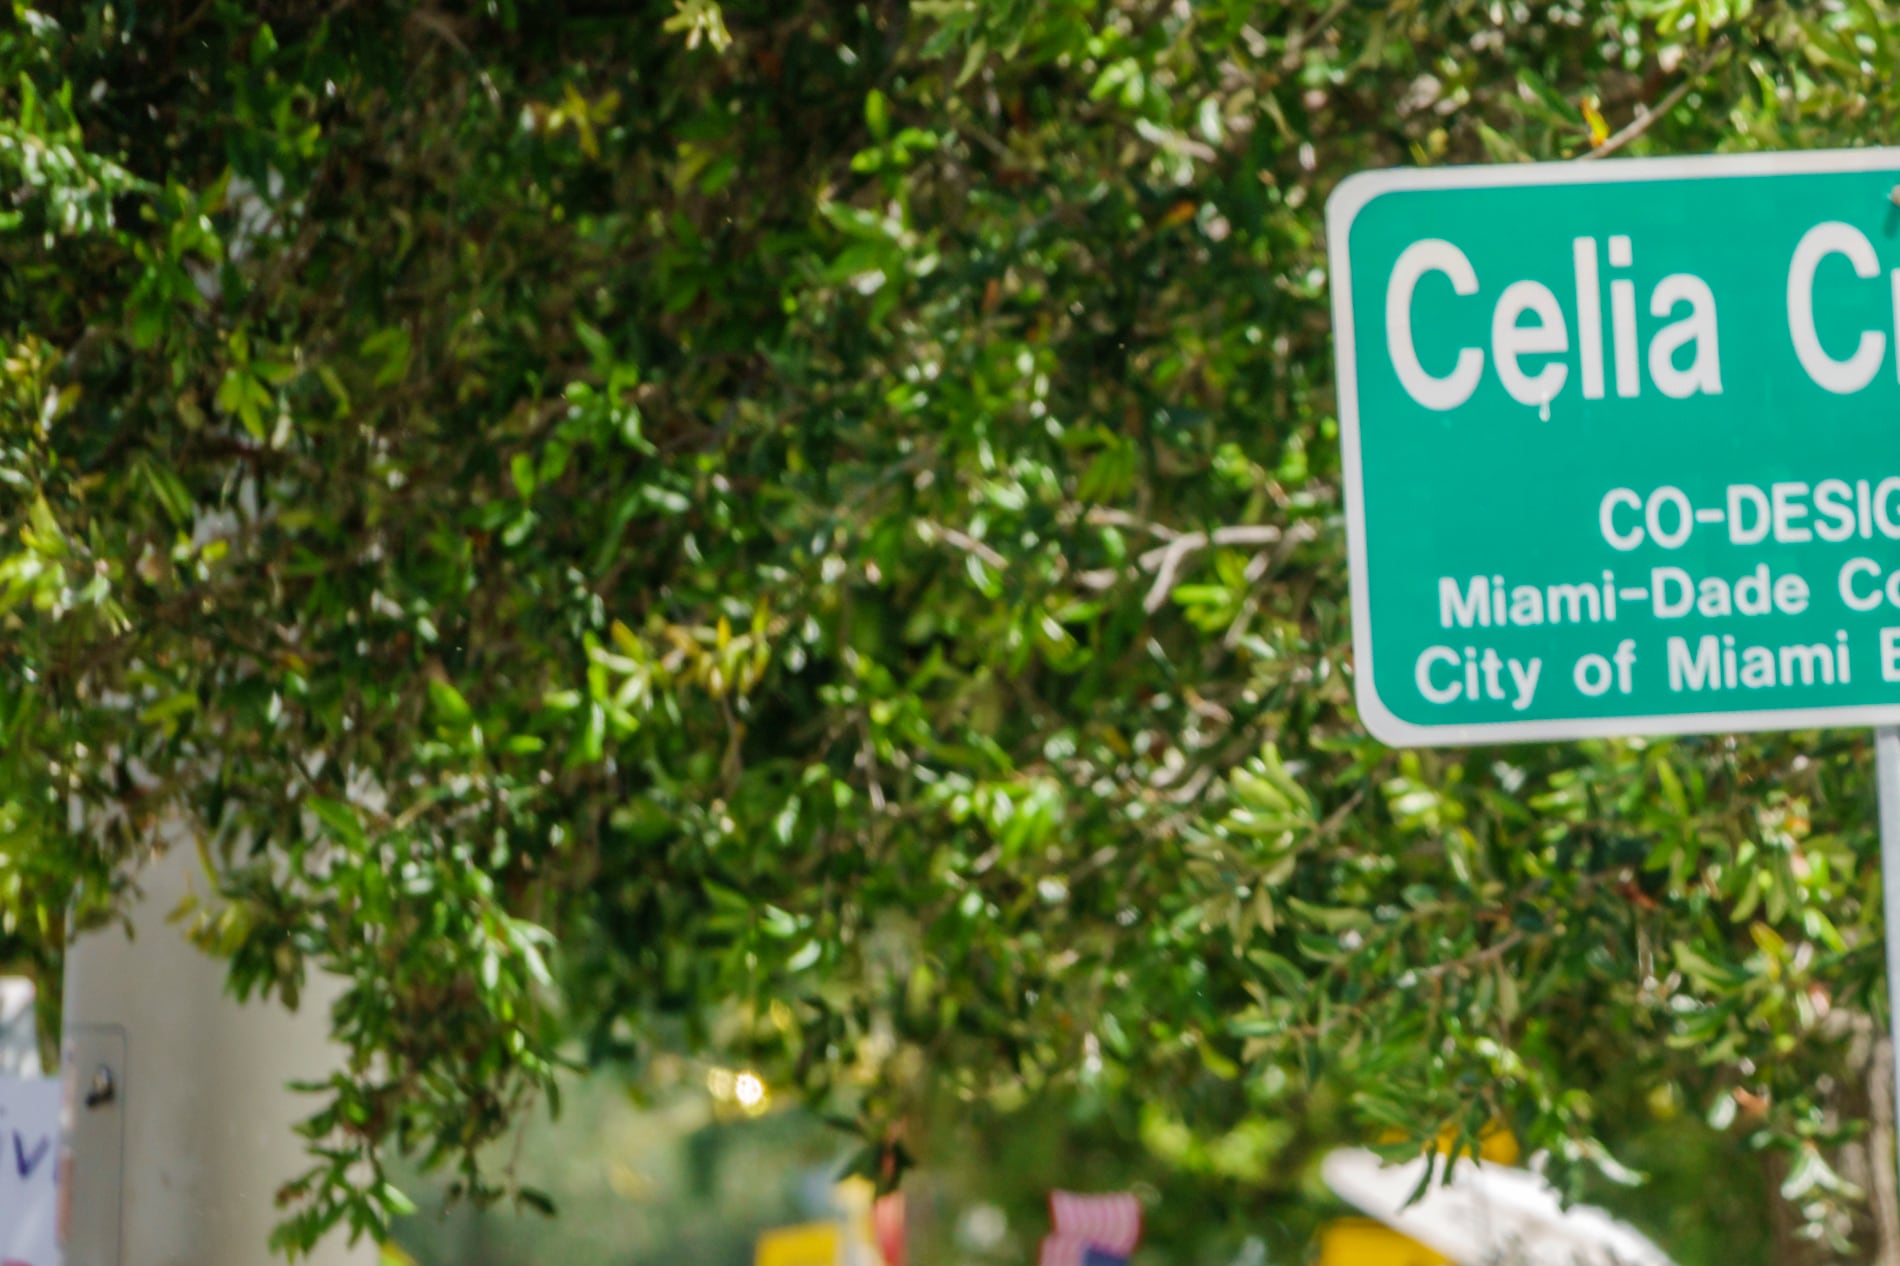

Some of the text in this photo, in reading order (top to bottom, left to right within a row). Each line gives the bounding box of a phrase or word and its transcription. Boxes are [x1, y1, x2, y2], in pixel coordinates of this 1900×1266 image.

[1386, 235, 1722, 411] Celia
[1439, 565, 1810, 628] Miami-Dade
[1415, 646, 1542, 709] City
[1573, 639, 1636, 696] of
[1667, 628, 1850, 690] Miami
